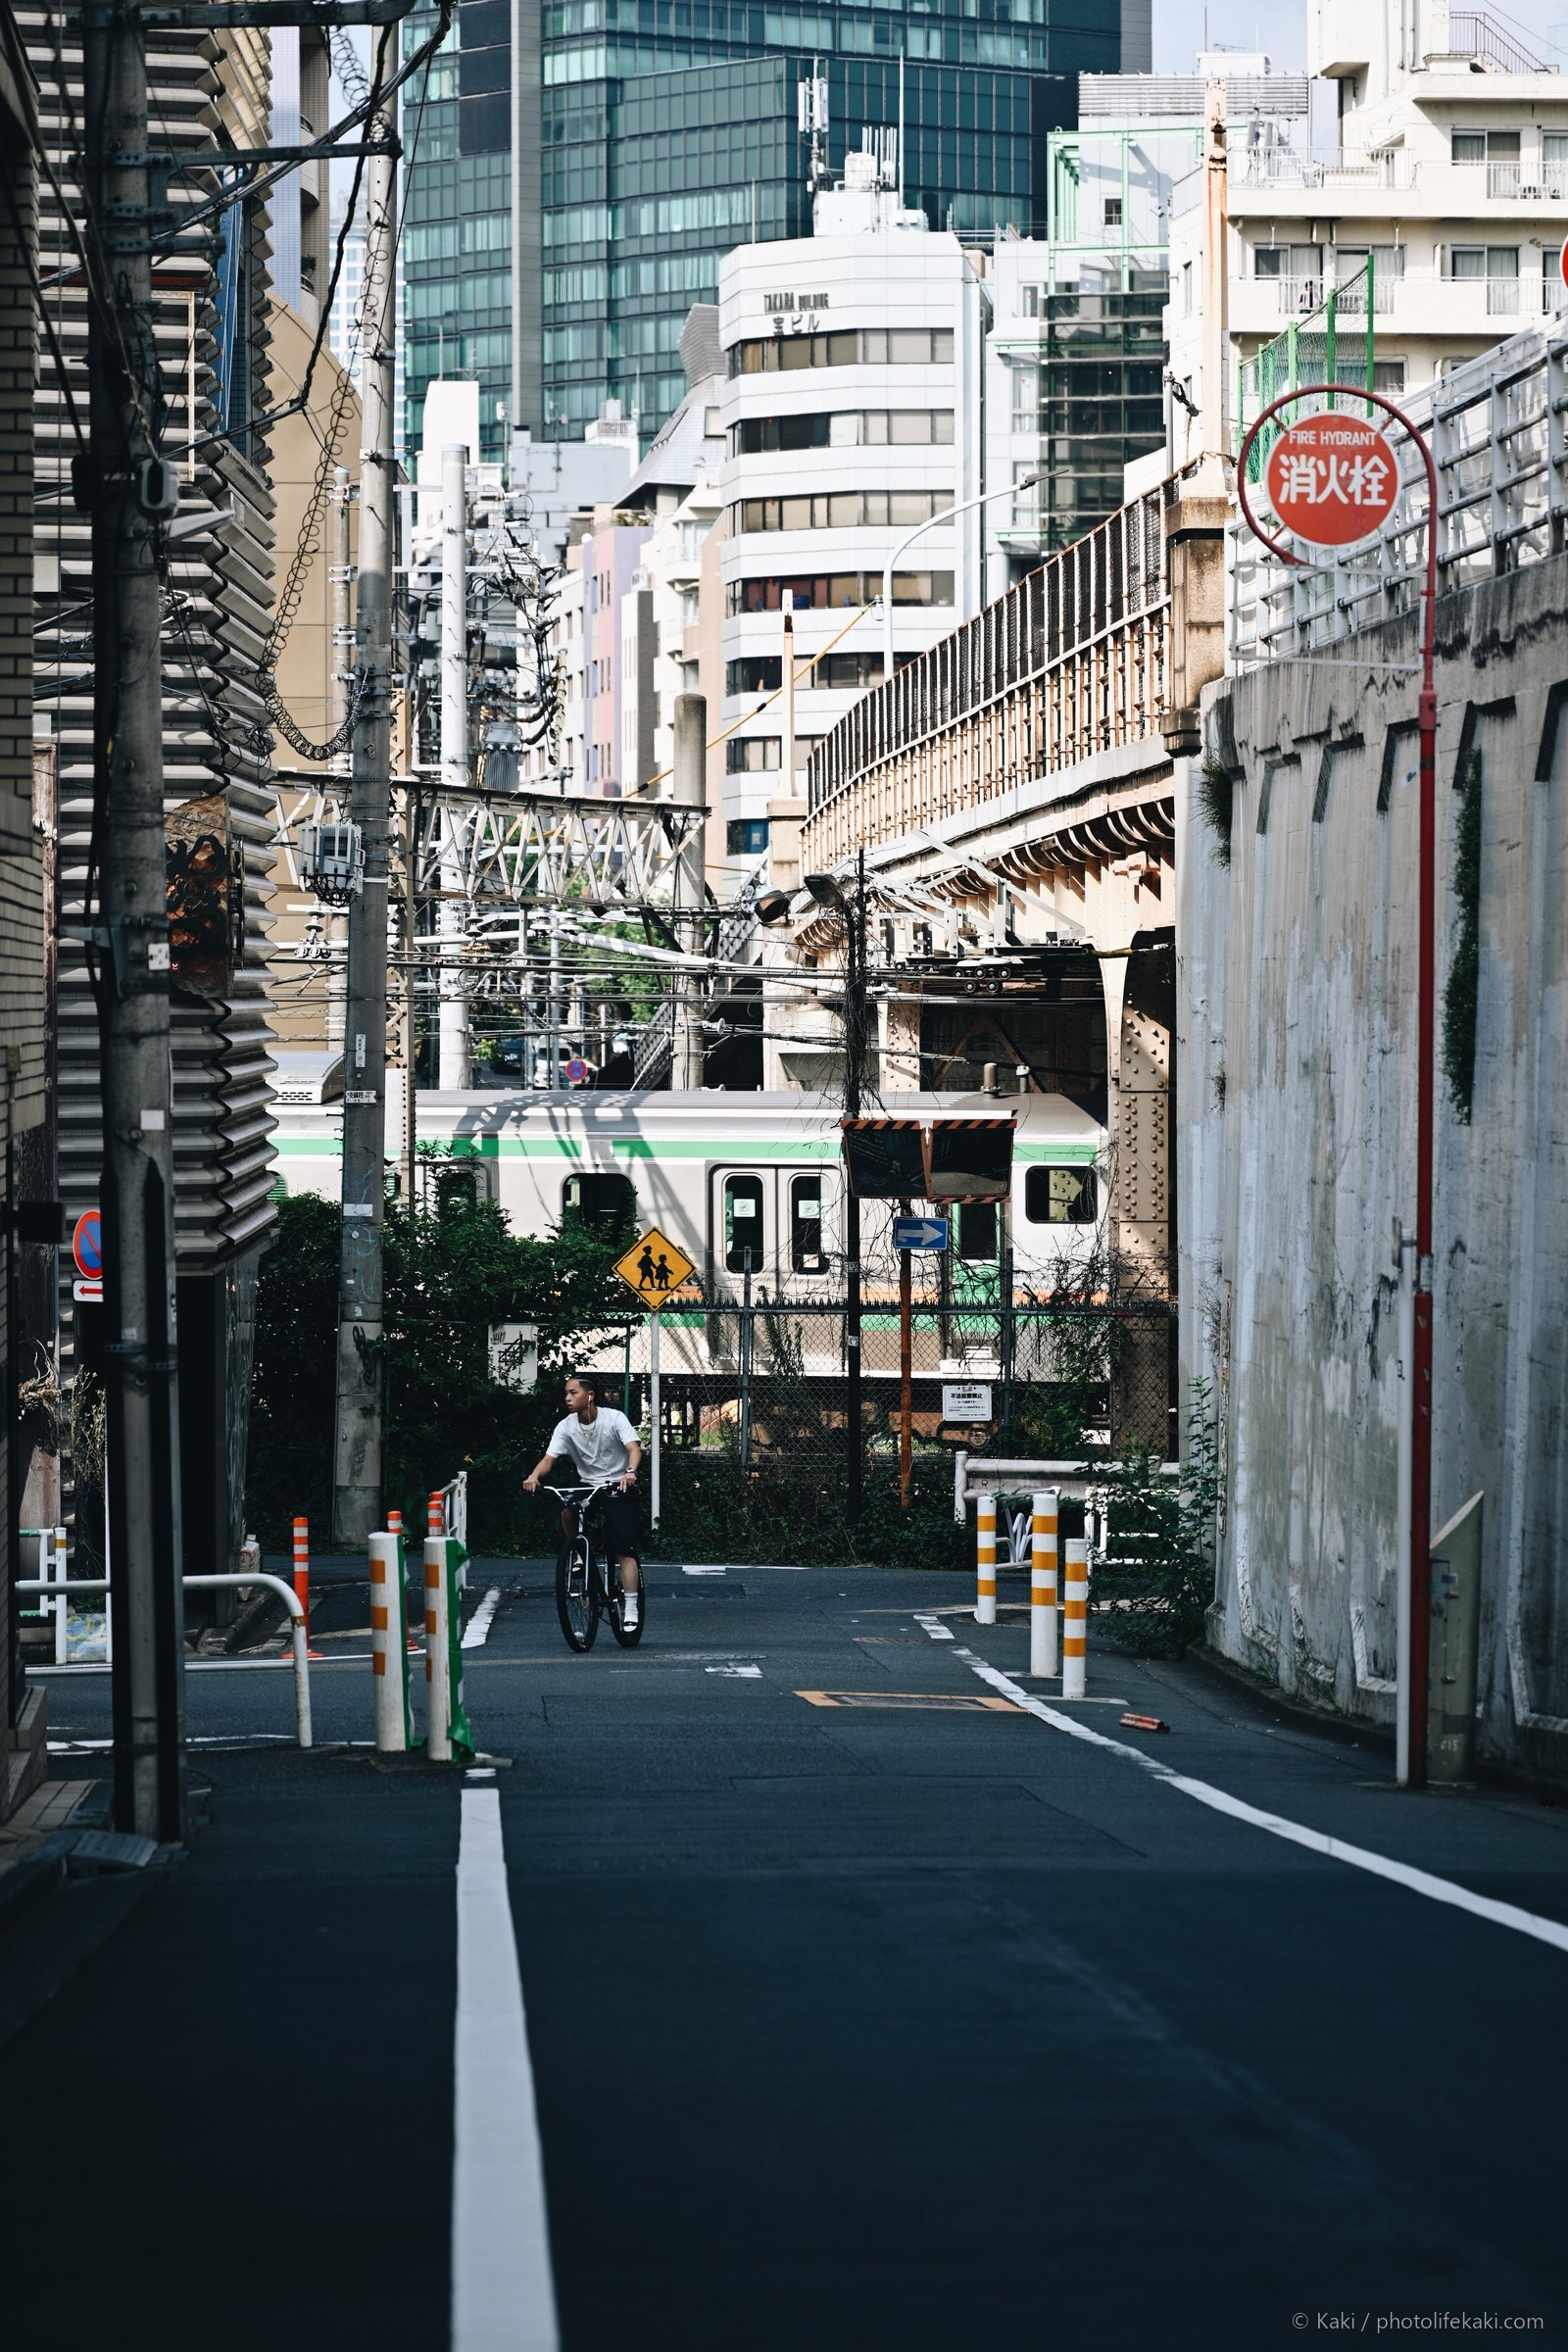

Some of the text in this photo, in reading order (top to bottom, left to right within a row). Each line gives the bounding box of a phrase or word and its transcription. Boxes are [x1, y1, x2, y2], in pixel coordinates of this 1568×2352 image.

[1289, 429, 1378, 446] FIRE HYDRANT
[1278, 454, 1390, 506] 消火栓
